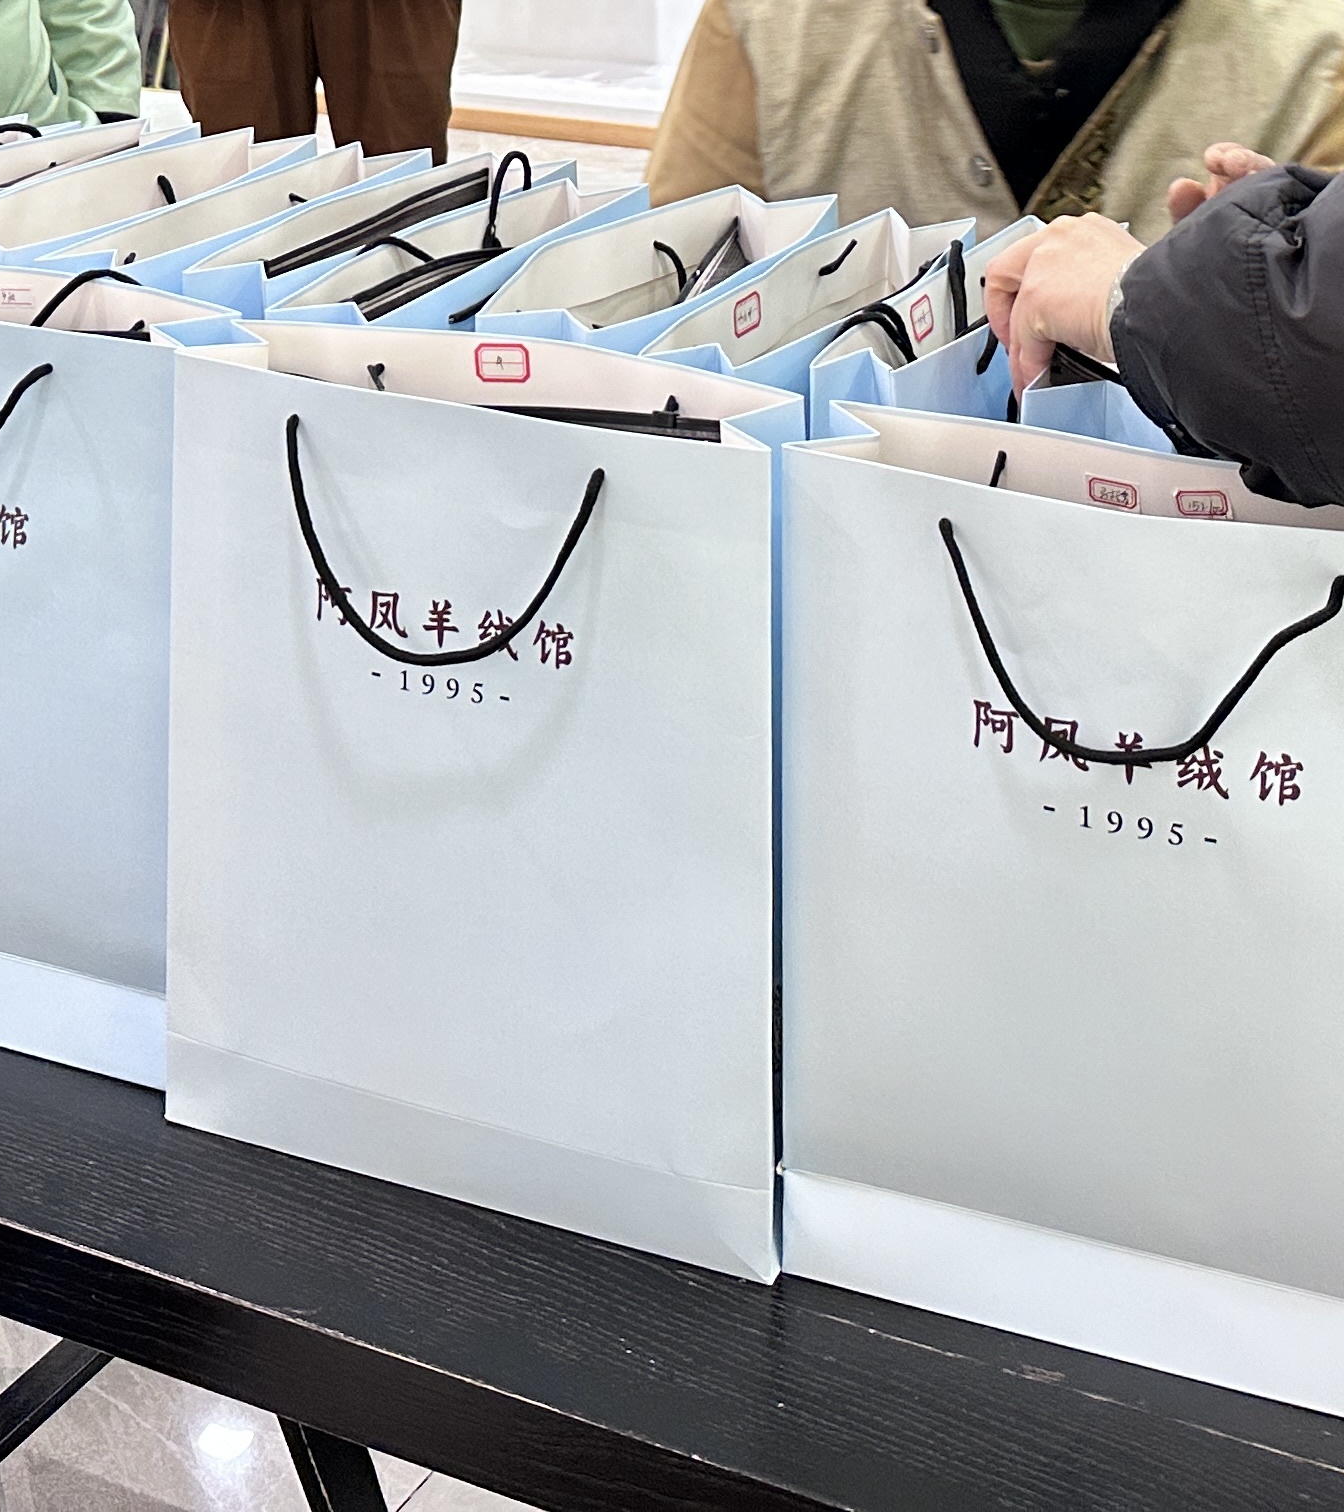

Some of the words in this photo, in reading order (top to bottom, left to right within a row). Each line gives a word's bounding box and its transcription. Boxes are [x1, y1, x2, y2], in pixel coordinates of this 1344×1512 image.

[972, 698, 1305, 806] 阿凤羊绒馆
